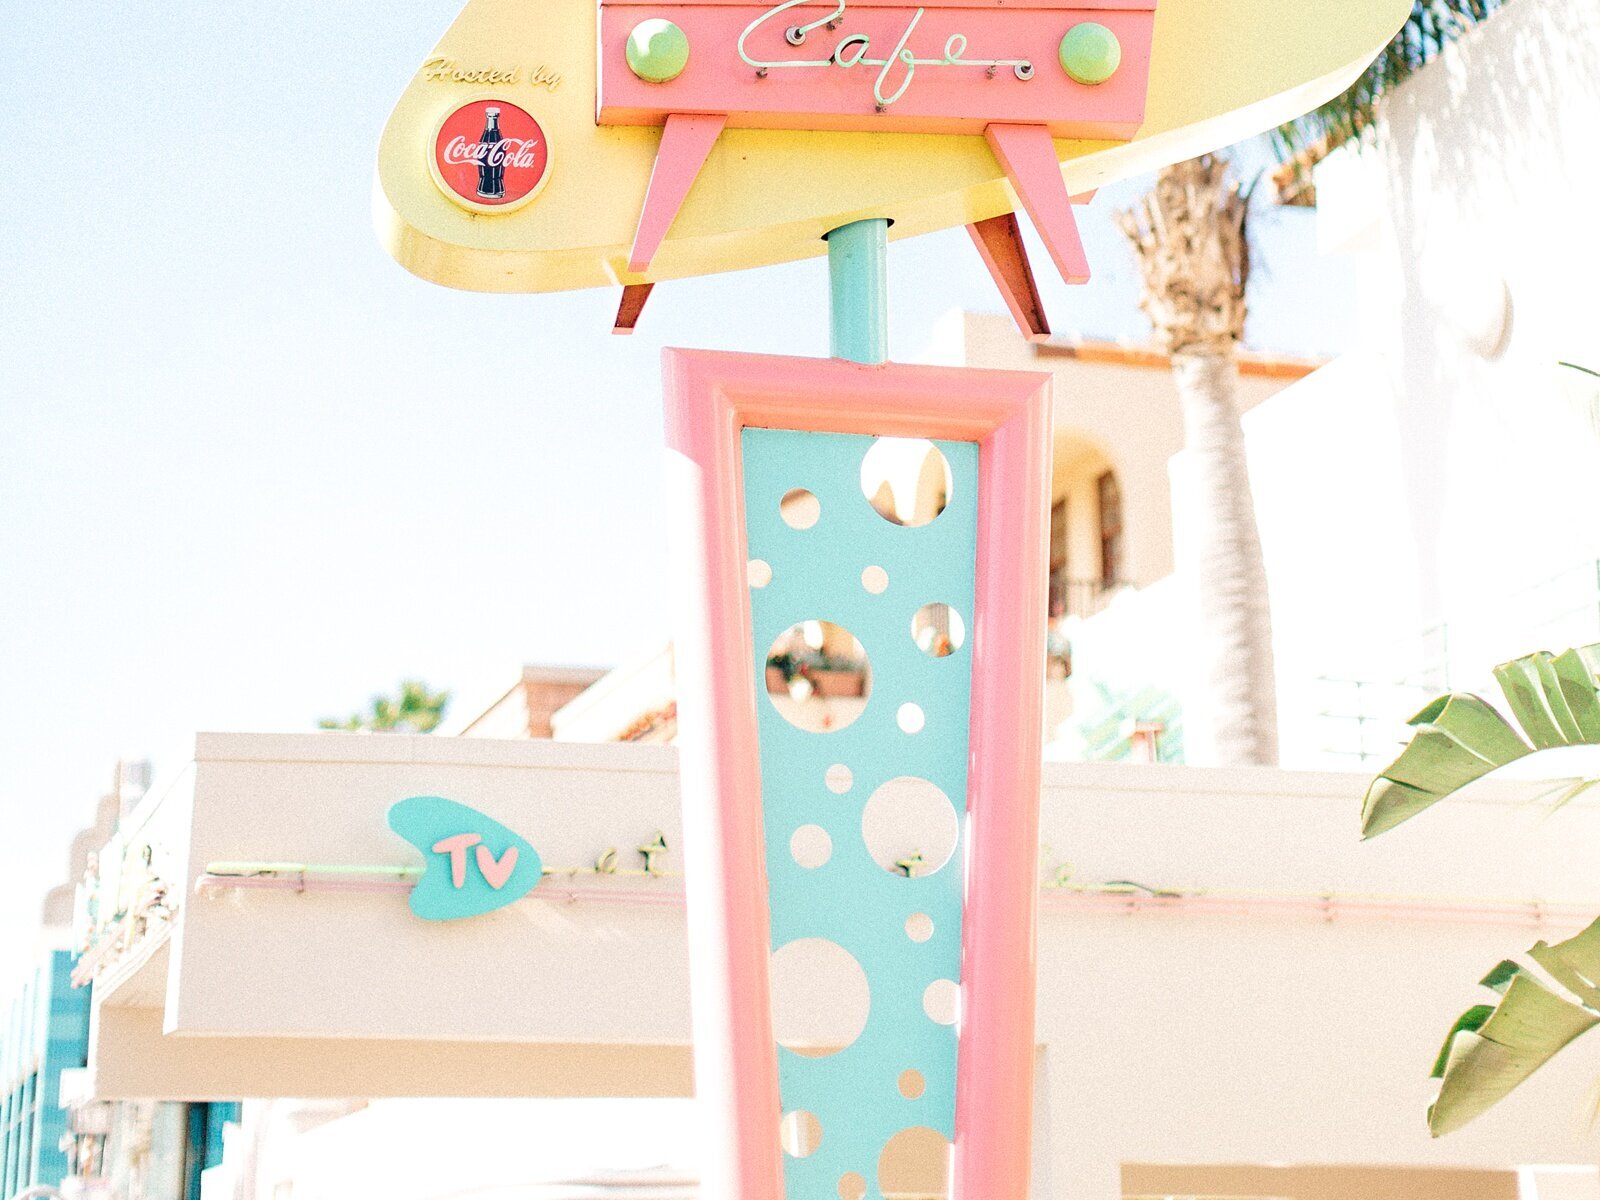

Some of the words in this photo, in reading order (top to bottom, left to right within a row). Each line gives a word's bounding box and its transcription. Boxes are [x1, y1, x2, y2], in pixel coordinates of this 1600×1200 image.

[423, 56, 522, 86] Hosted
[531, 64, 562, 92] by
[443, 135, 538, 169] Coca-Cola
[431, 832, 519, 890] TV
